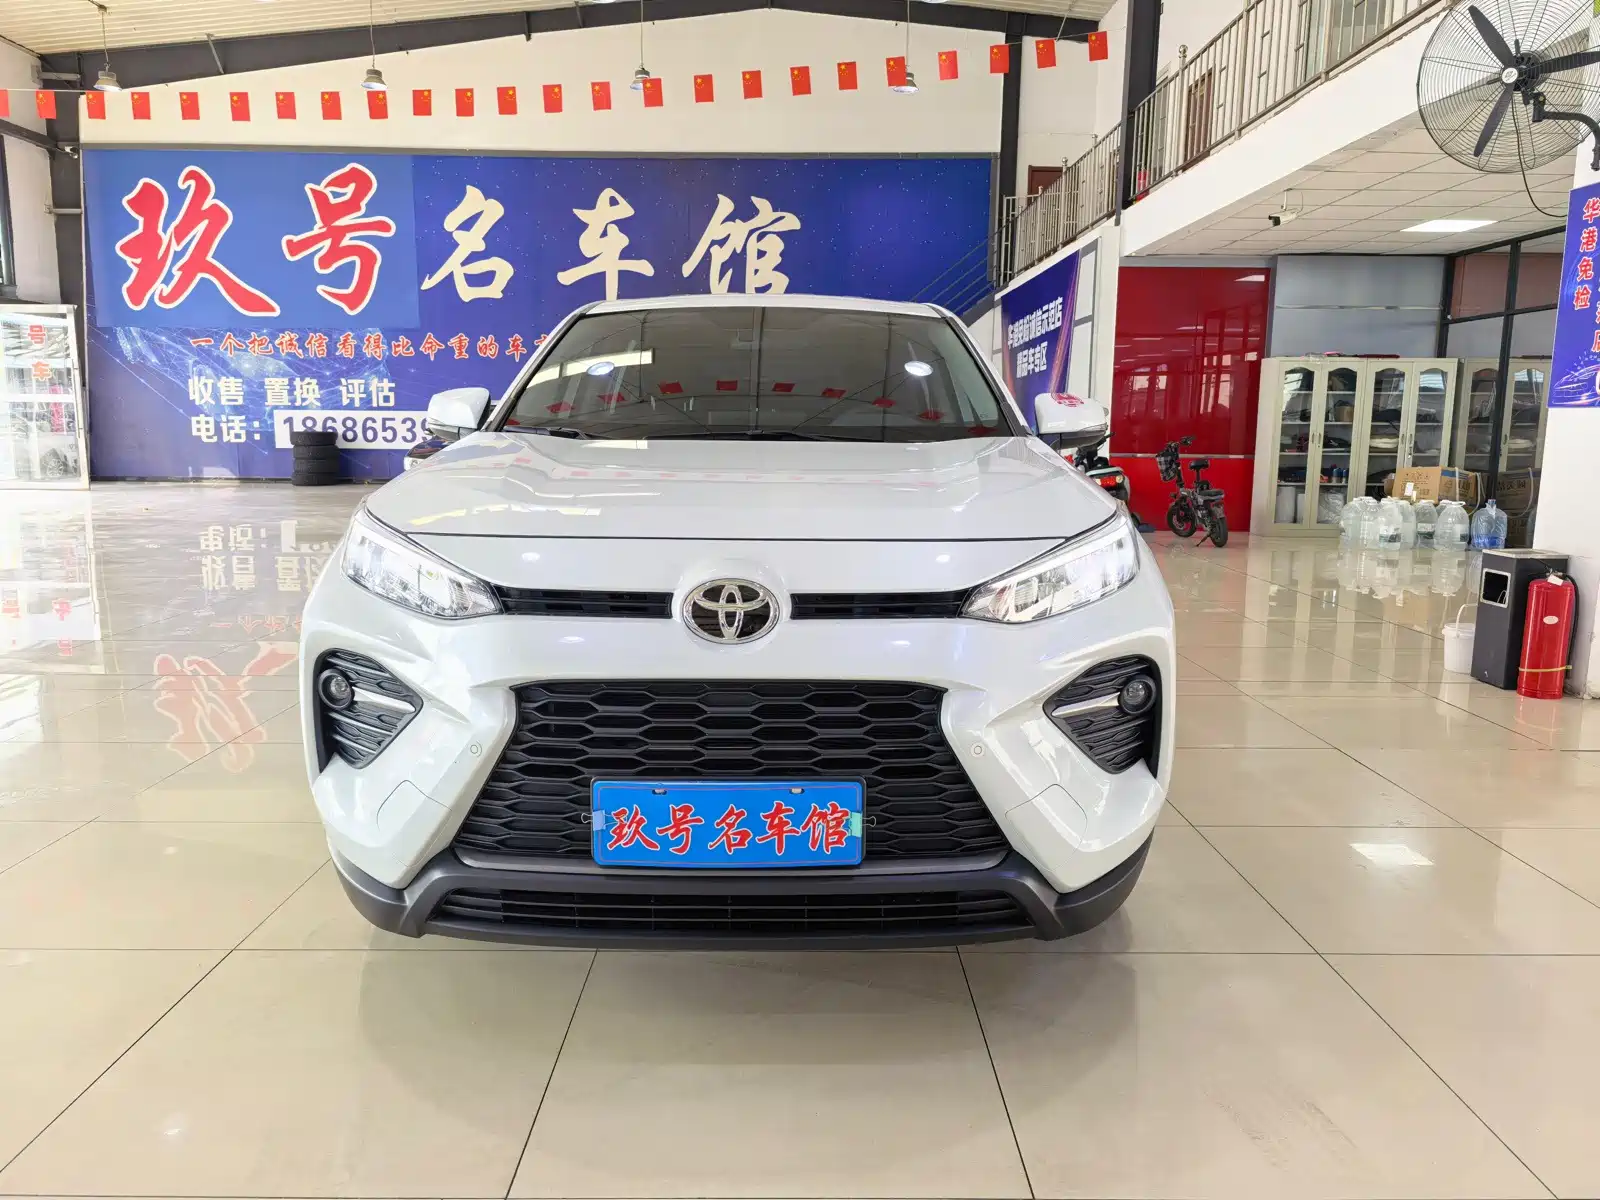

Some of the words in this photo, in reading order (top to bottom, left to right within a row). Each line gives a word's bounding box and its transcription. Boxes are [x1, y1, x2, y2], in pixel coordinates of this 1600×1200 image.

[115, 162, 802, 317] 玖号名车馆
[190, 330, 548, 362] 一个把诚信看得比命重的车
[188, 377, 244, 406] 收售
[264, 377, 321, 407] 置换
[340, 377, 396, 407] 评估
[606, 800, 851, 856] 玖号名车馆
